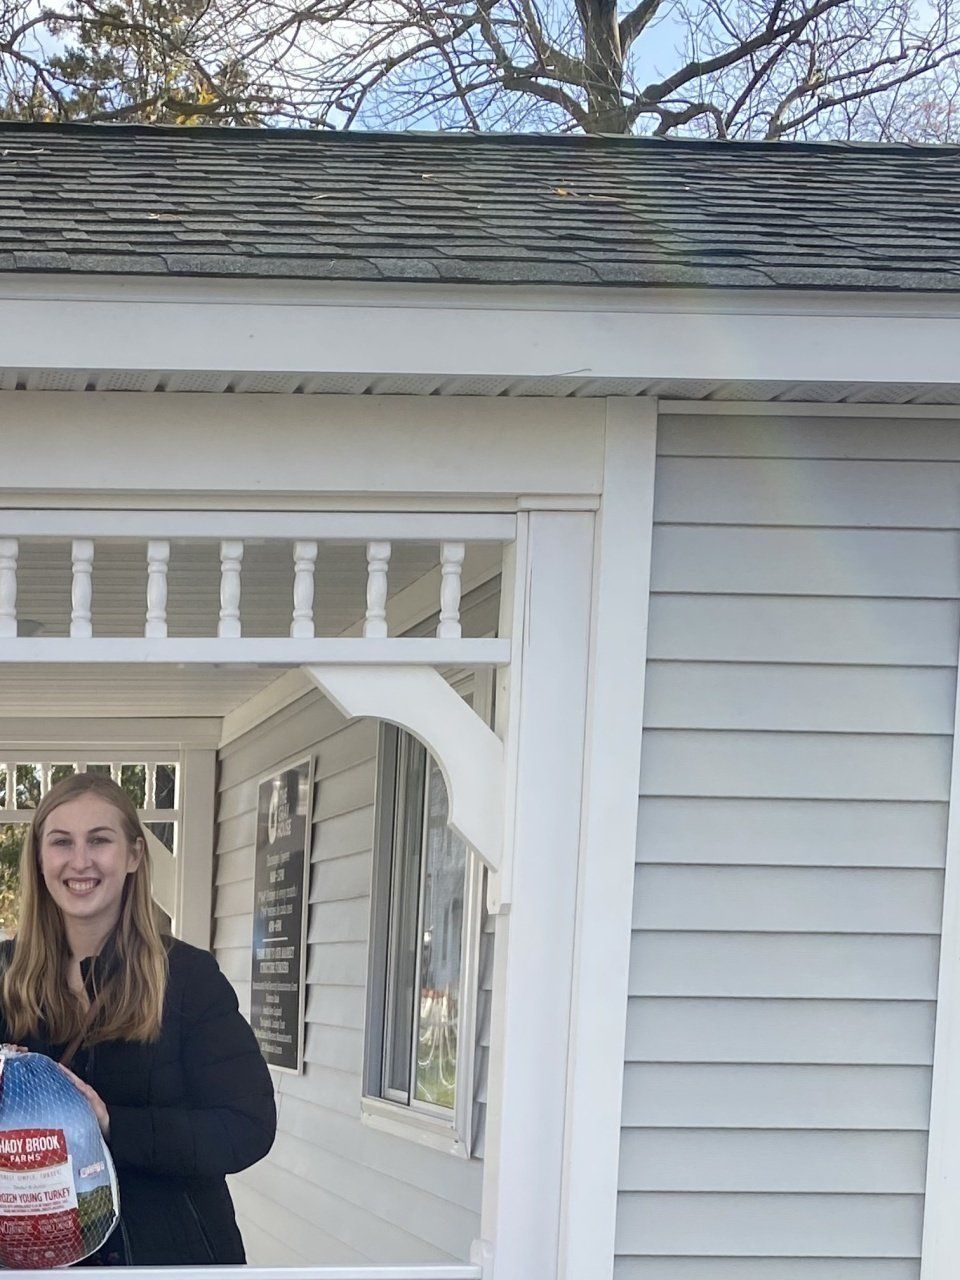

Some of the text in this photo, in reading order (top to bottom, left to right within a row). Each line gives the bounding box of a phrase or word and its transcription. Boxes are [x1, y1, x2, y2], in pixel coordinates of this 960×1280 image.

[26, 1135, 60, 1152] BROOK
[10, 1154, 41, 1163] FARMS
[19, 1190, 43, 1203] YOUNG
[44, 1186, 70, 1201] TURKEY
